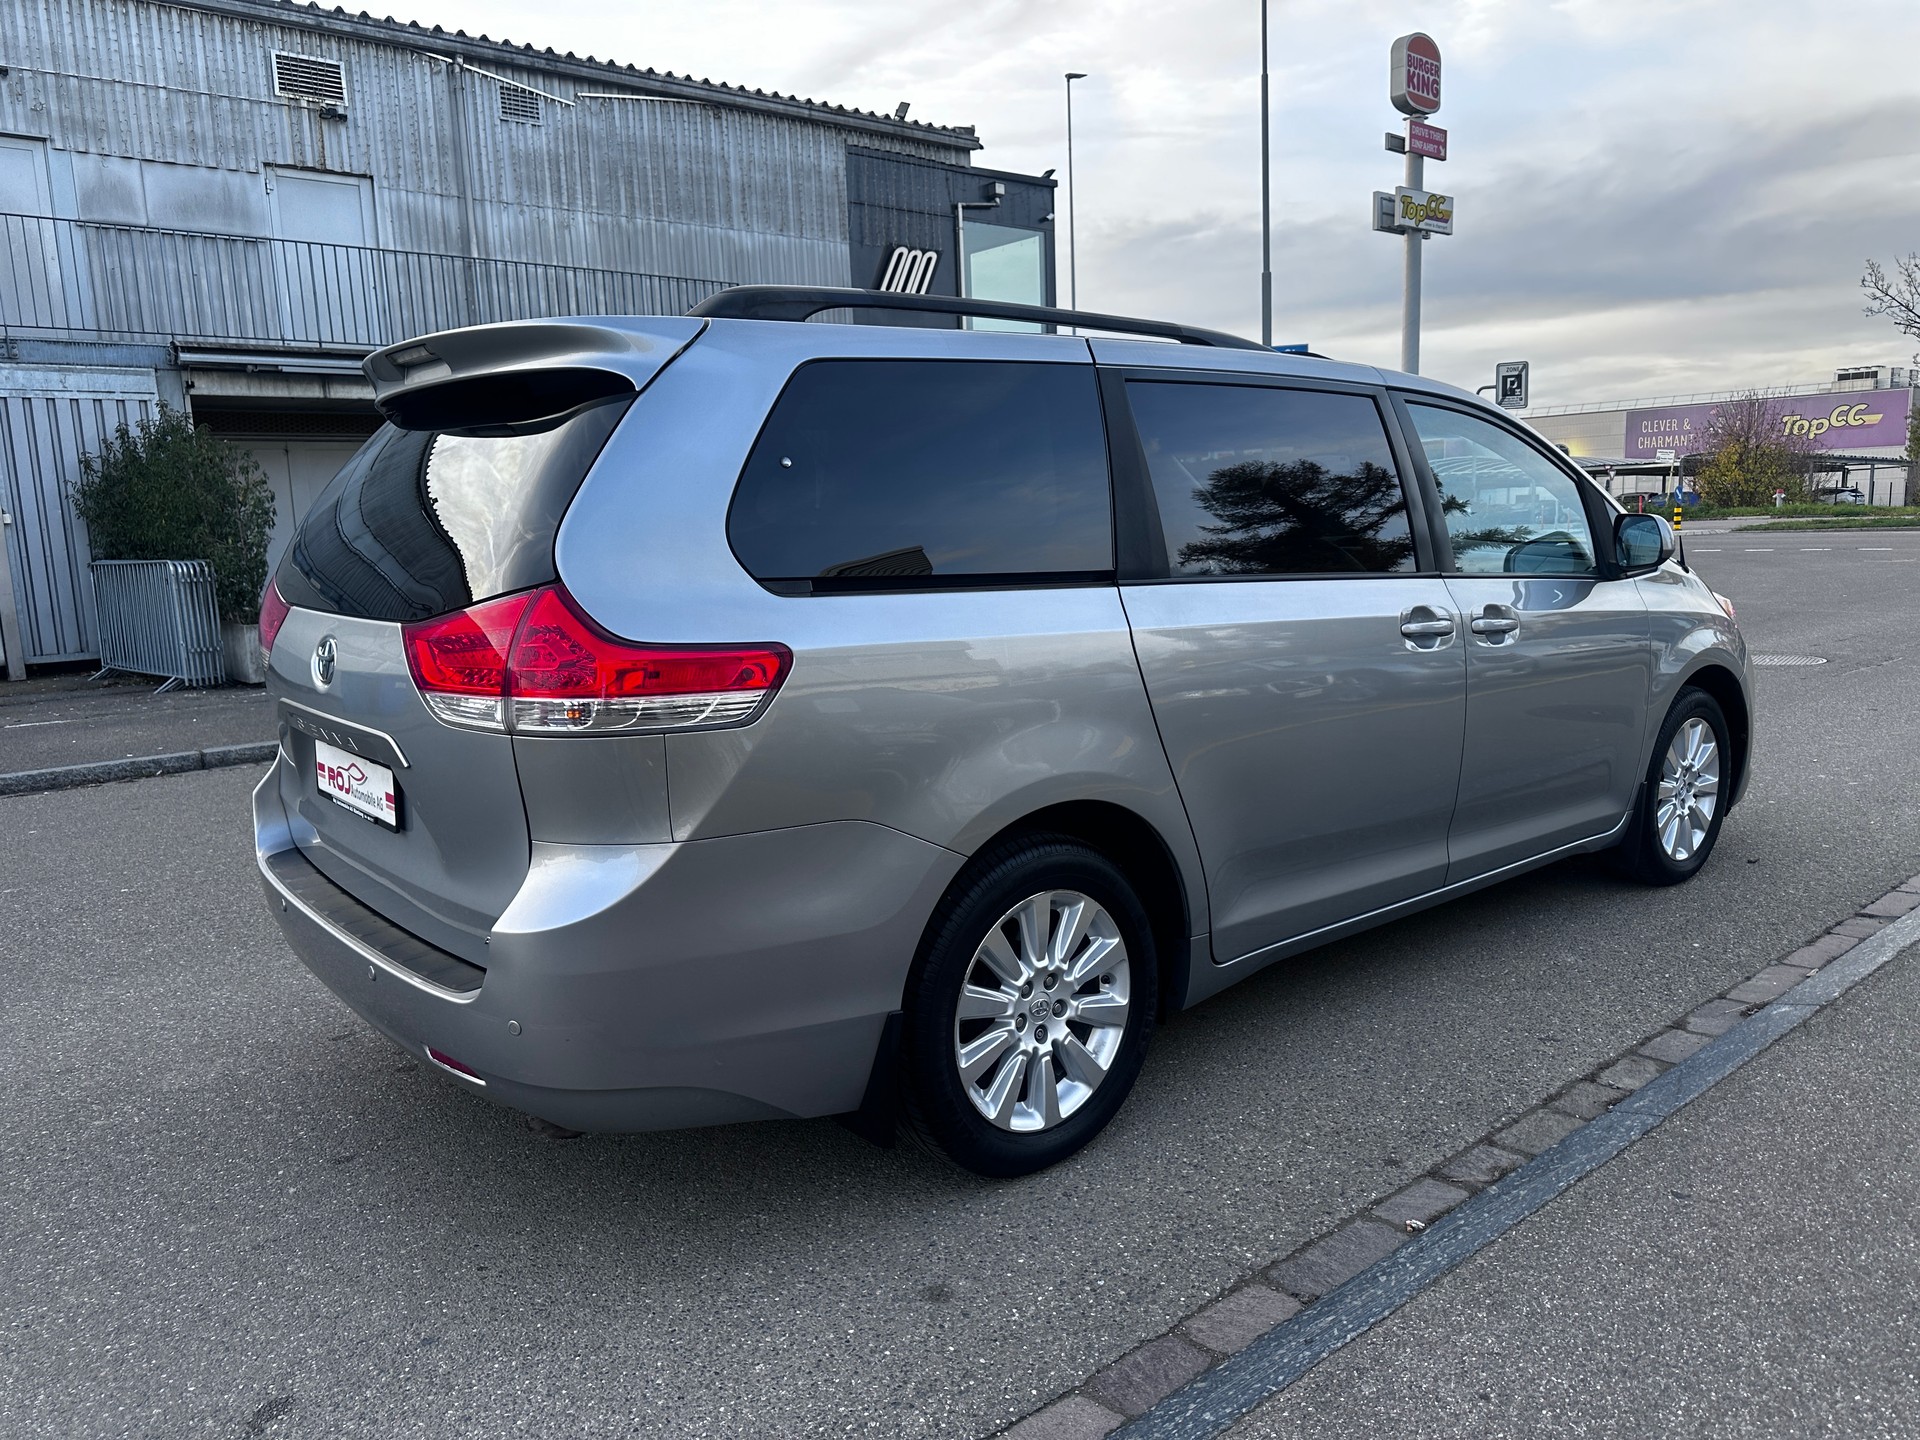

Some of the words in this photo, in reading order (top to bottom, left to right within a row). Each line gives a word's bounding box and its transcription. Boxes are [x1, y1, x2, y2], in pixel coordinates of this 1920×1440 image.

[1407, 53, 1440, 79] BURGER
[1407, 68, 1439, 98] KING
[1411, 125, 1430, 138] DRIVE
[1429, 130, 1446, 143] THRU
[1411, 138, 1438, 154] EINFAHRT
[1400, 194, 1447, 228] TopCC
[1641, 418, 1679, 433] CLEVER
[1683, 417, 1692, 431] &
[1782, 403, 1870, 440] TopCC
[296, 716, 359, 751] SENNA
[327, 765, 351, 795] ROJ
[350, 784, 376, 808] Automobile
[376, 795, 384, 811] AG
